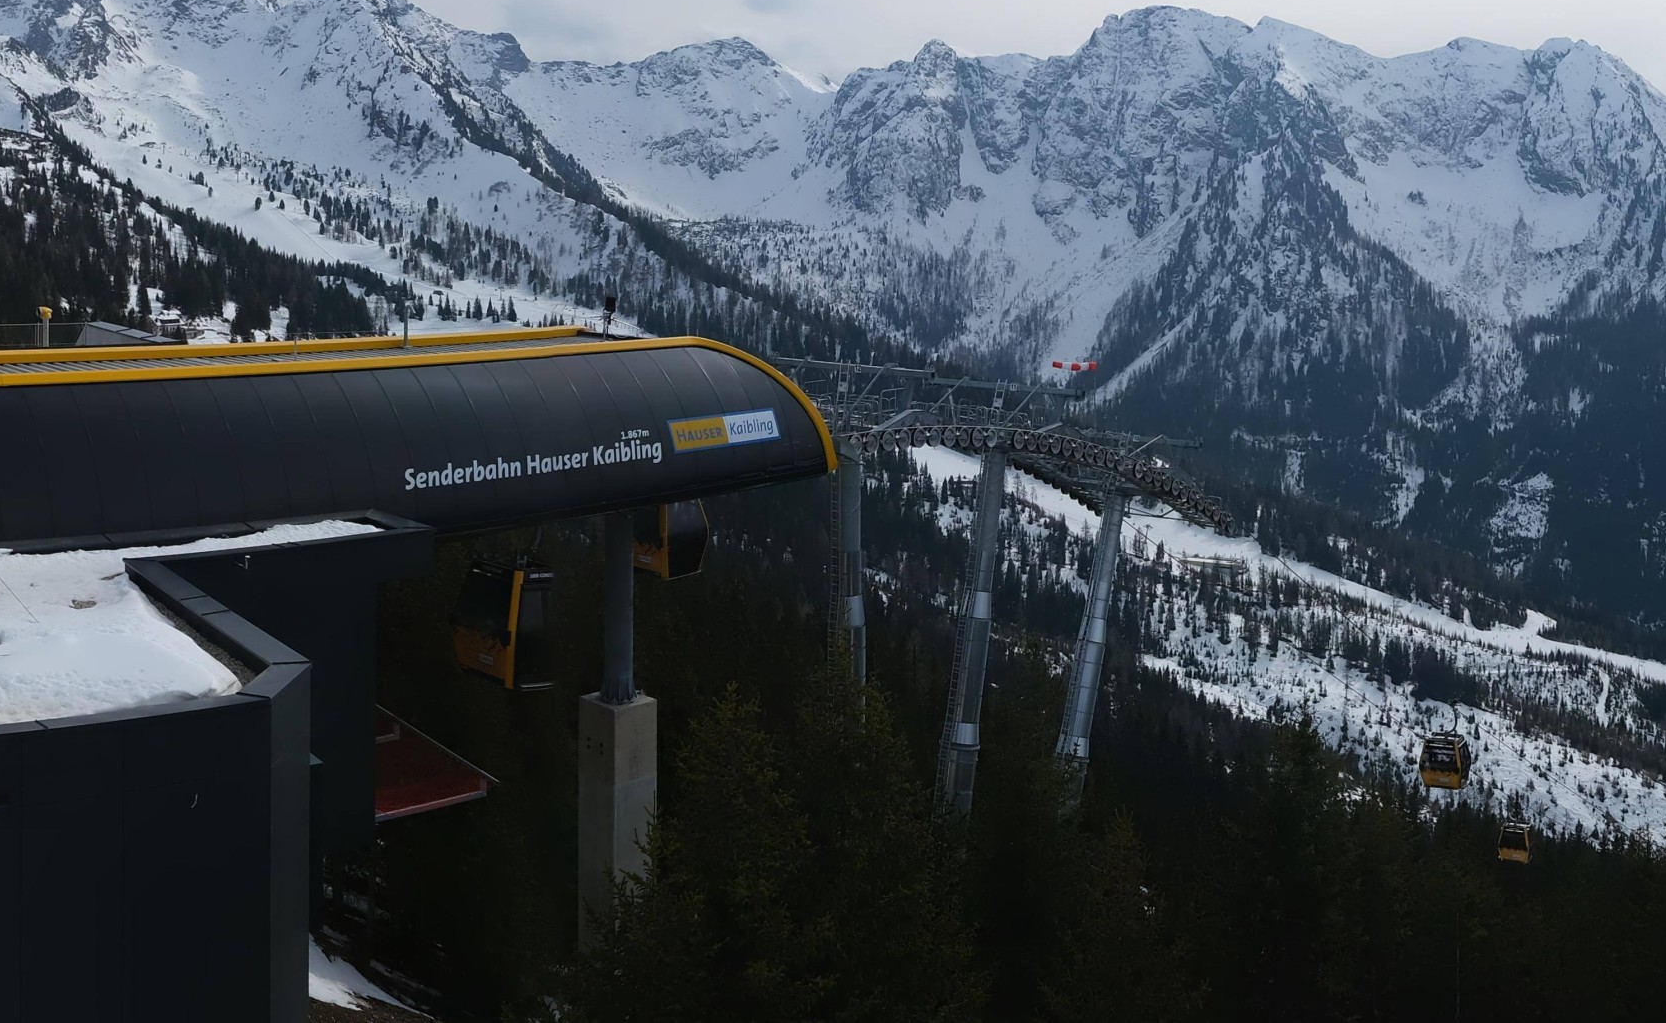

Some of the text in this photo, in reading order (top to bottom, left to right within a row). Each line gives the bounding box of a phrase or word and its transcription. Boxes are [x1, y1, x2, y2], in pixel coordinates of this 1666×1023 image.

[676, 417, 774, 442] HAUSER Kaibling
[405, 439, 663, 490] Senderbahn Hauser Kaibling
